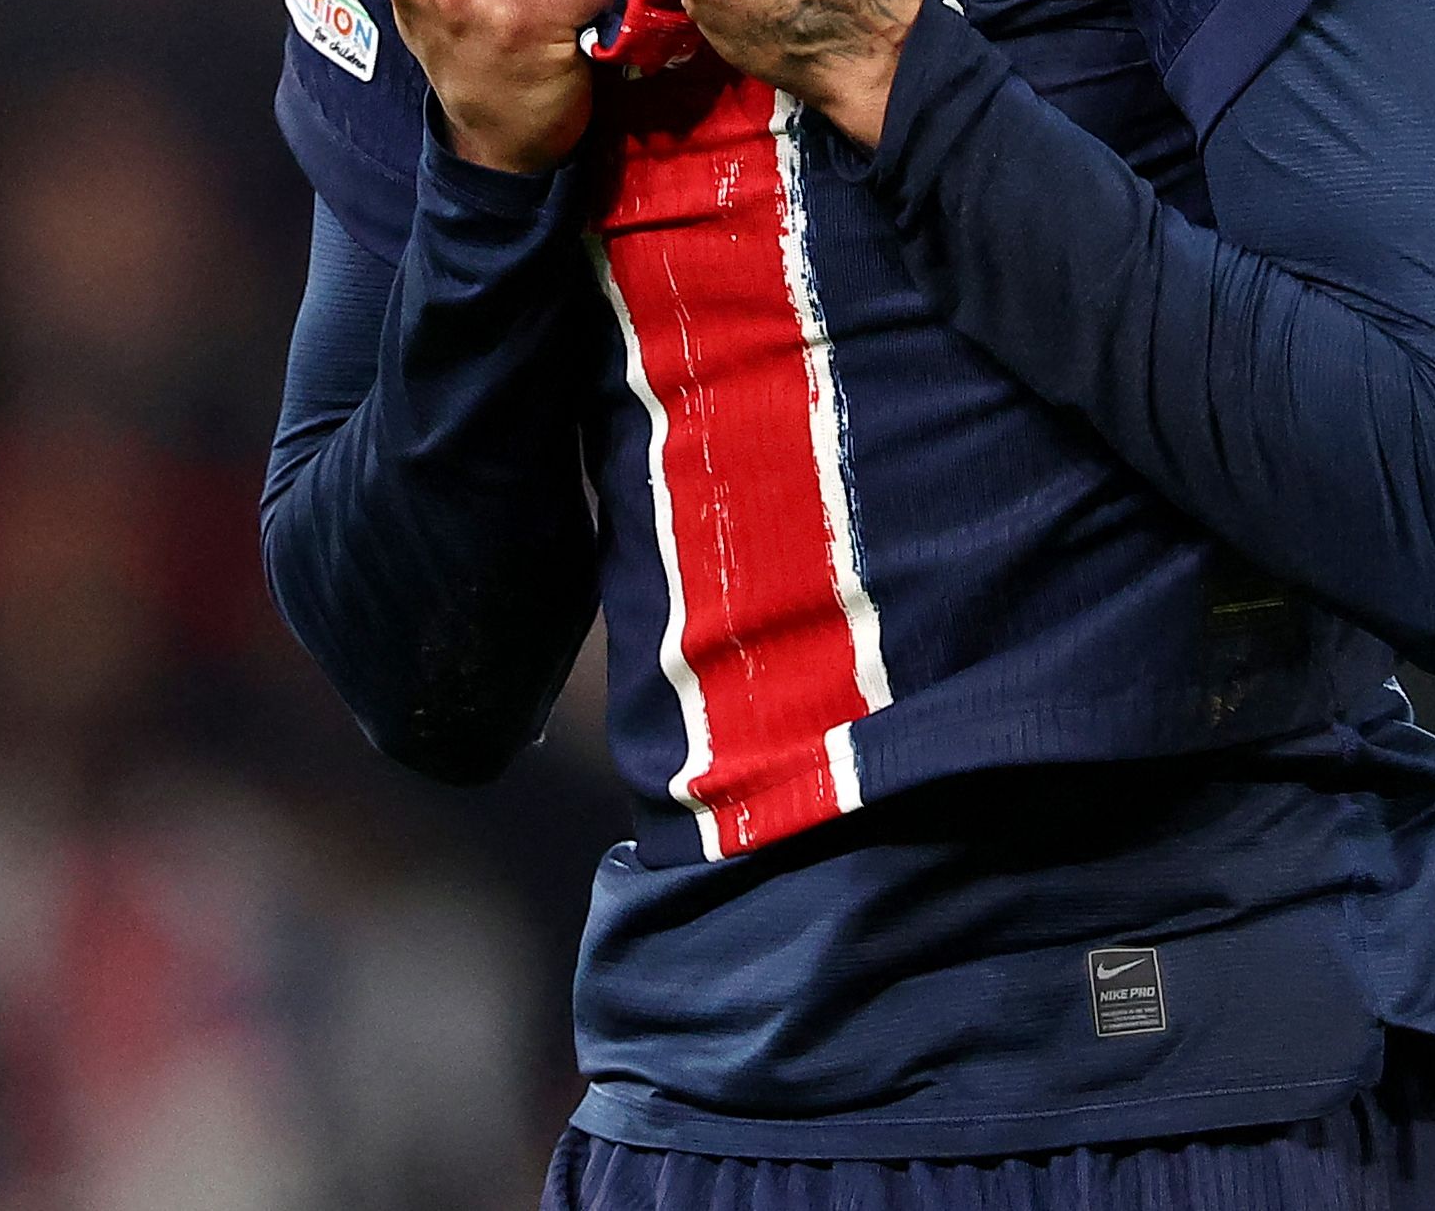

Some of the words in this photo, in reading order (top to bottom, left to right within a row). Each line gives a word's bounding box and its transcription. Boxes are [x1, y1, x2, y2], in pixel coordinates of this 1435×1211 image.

[329, 41, 367, 72] children
[1100, 989, 1128, 1002] NIKE
[1130, 987, 1155, 998] PRO
